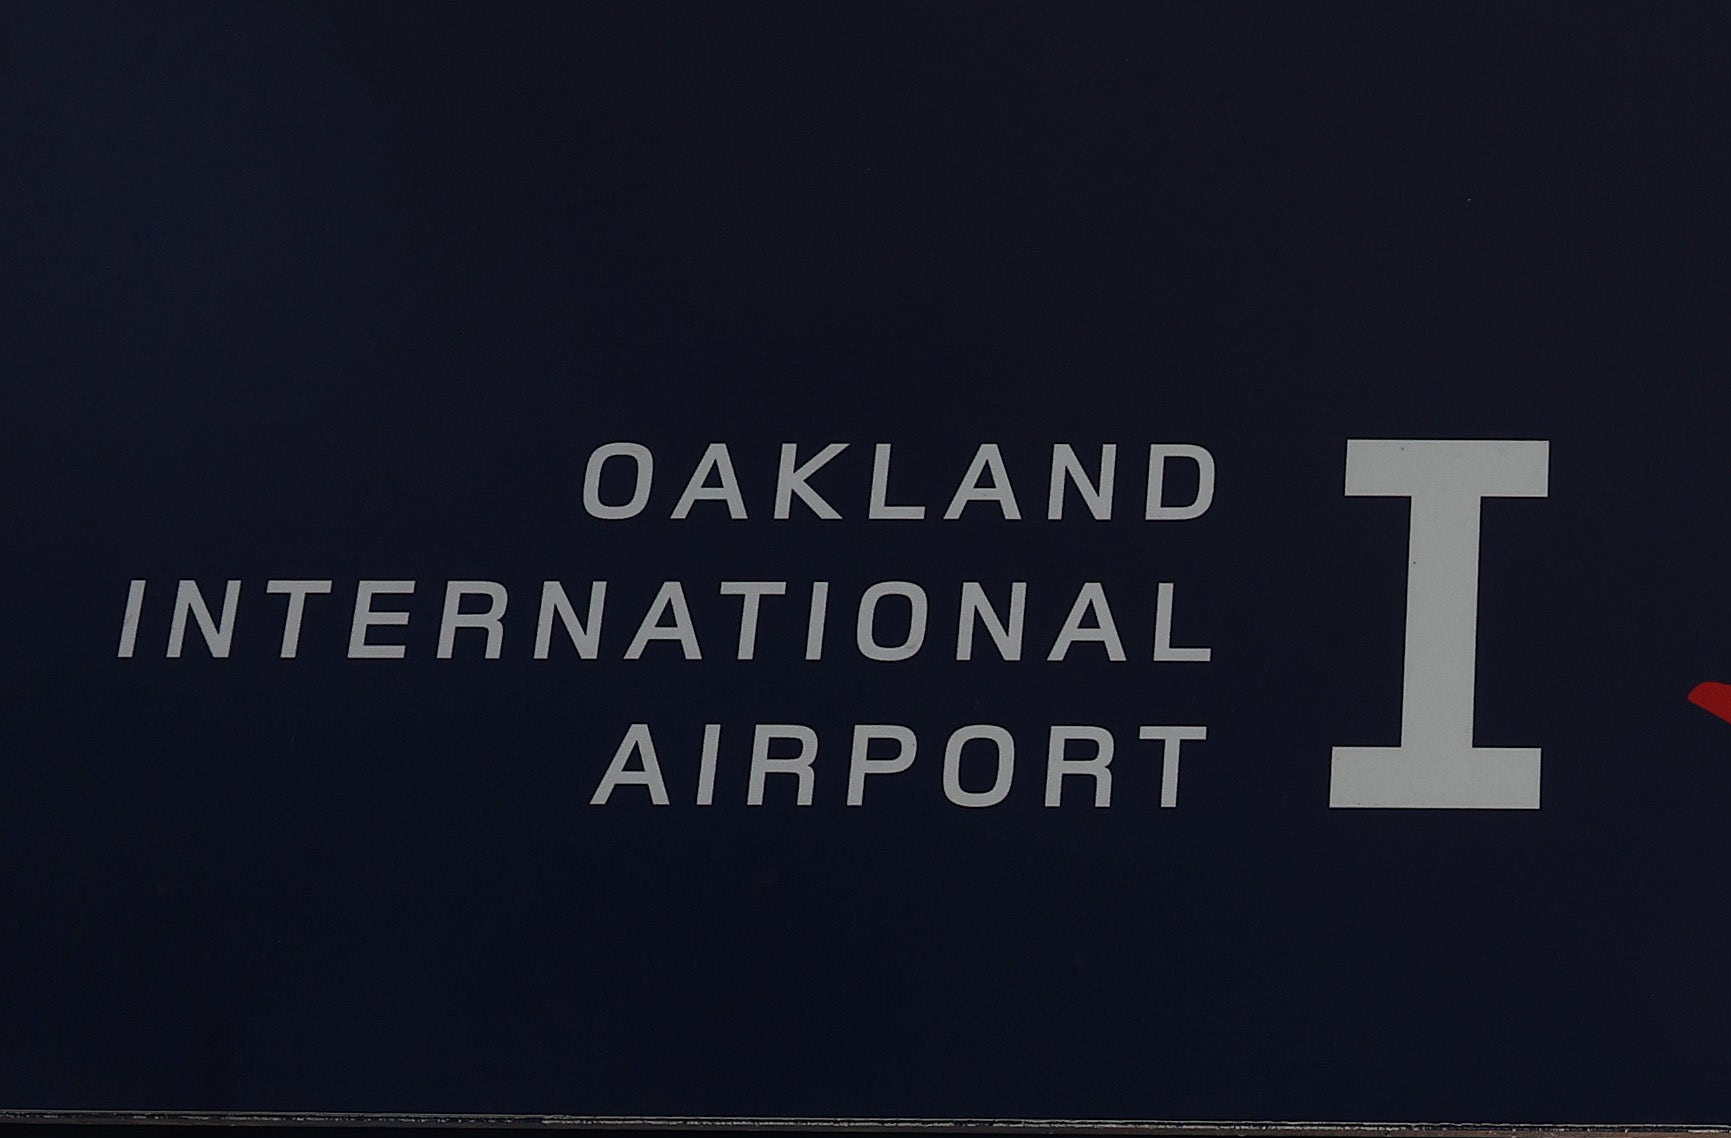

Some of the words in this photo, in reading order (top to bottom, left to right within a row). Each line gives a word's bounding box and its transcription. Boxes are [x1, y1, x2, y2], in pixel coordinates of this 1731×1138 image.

[583, 442, 1216, 521] OAKLAND
[117, 580, 1213, 662] INTERNATIONAL
[1329, 438, 1550, 810] I
[589, 723, 1208, 808] AIRPORT
